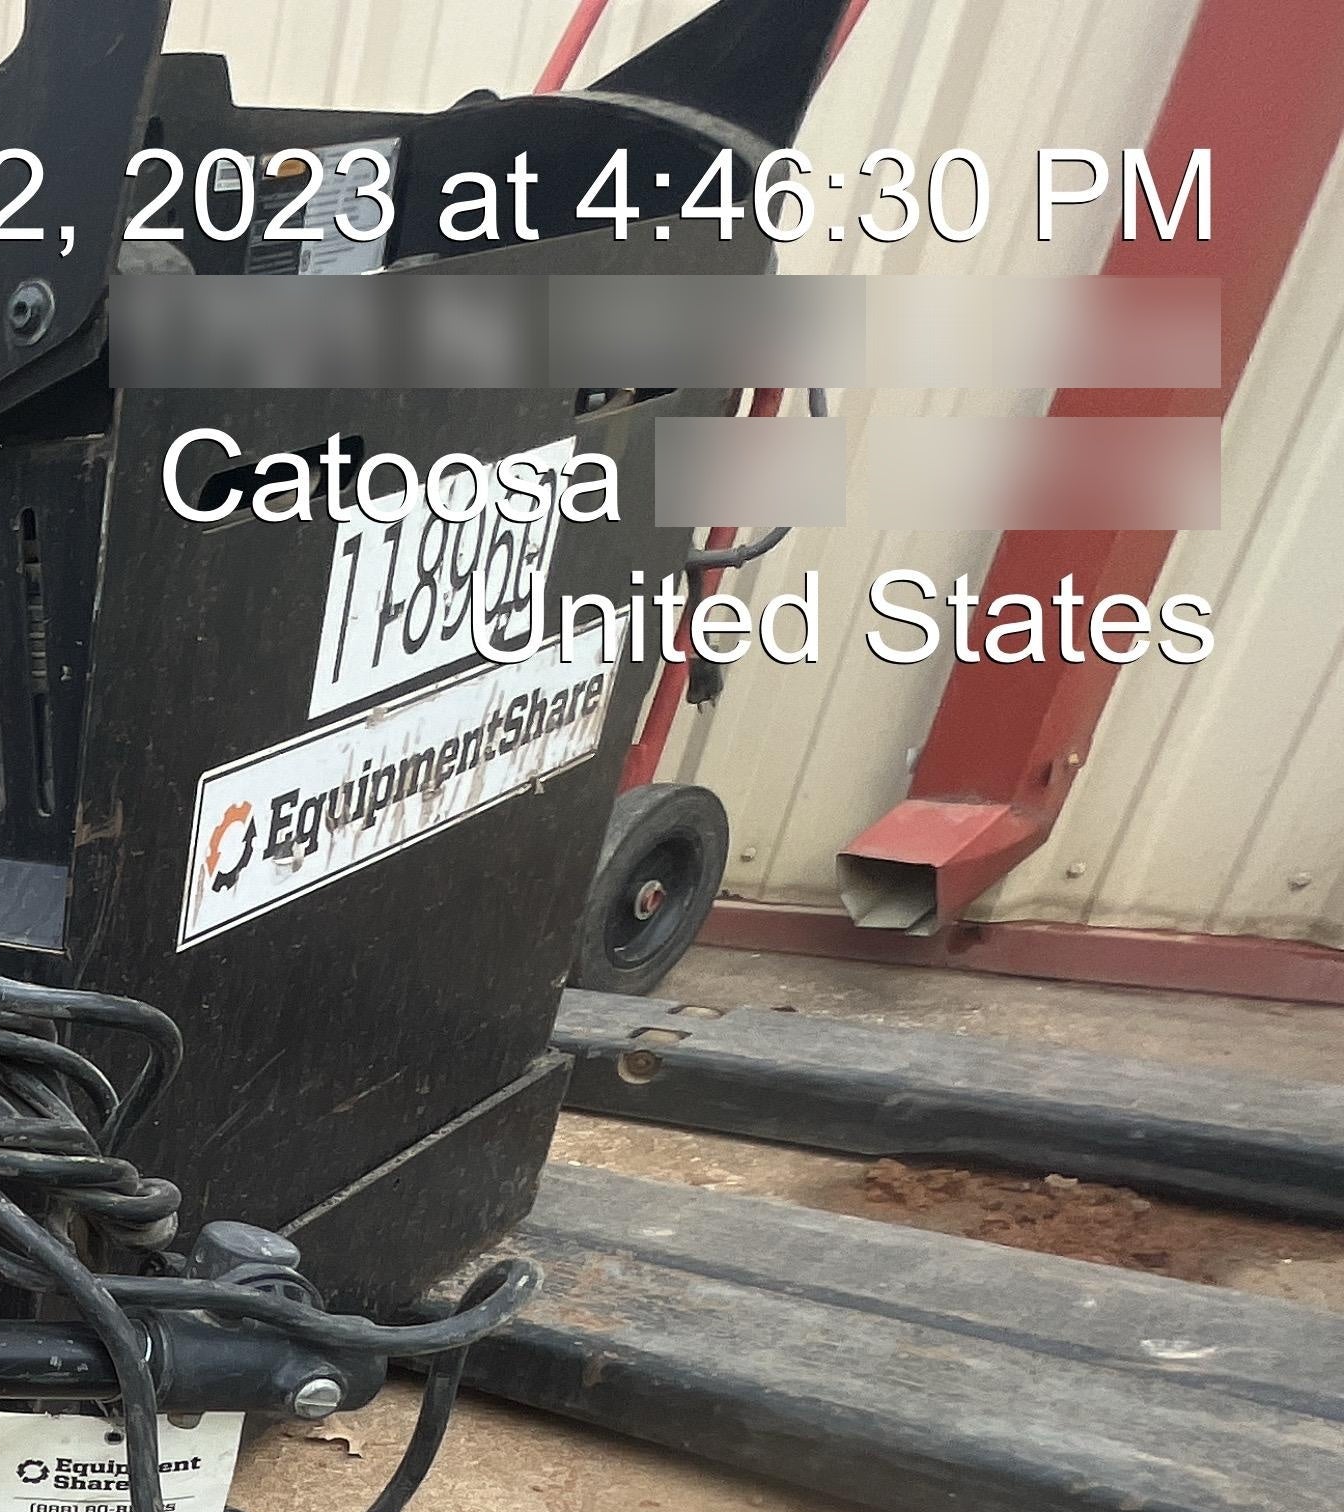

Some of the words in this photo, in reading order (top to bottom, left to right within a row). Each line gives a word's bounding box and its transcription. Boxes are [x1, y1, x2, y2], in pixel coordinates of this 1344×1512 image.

[262, 672, 603, 860] EquipmentShare
[55, 1456, 201, 1477] Equipent
[53, 1476, 130, 1491] Share
